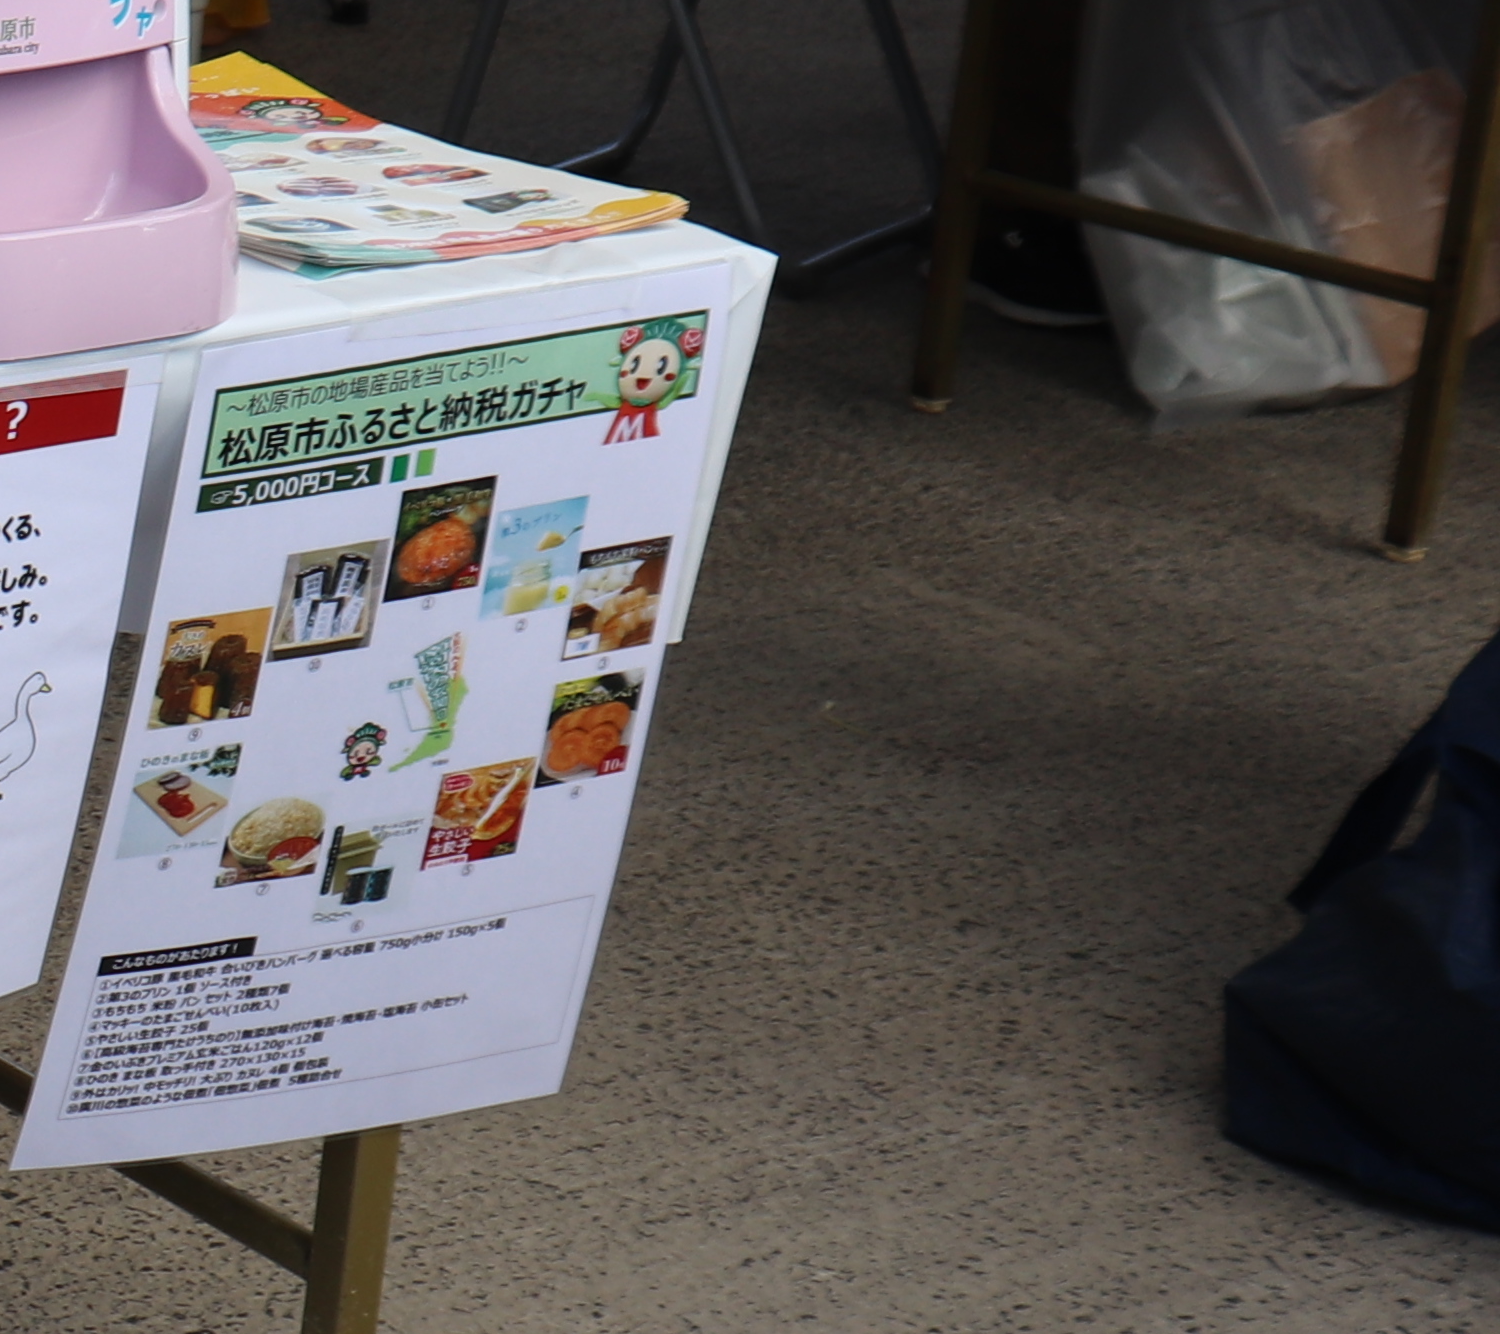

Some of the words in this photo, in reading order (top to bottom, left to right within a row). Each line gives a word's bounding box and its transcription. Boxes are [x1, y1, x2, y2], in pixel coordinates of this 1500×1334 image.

[17, 40, 40, 57] city
[218, 376, 588, 468] 松原市ふるさと納税ガチャ
[231, 463, 371, 506] 5,000円コース
[111, 943, 238, 971] こんなものがあたります!
